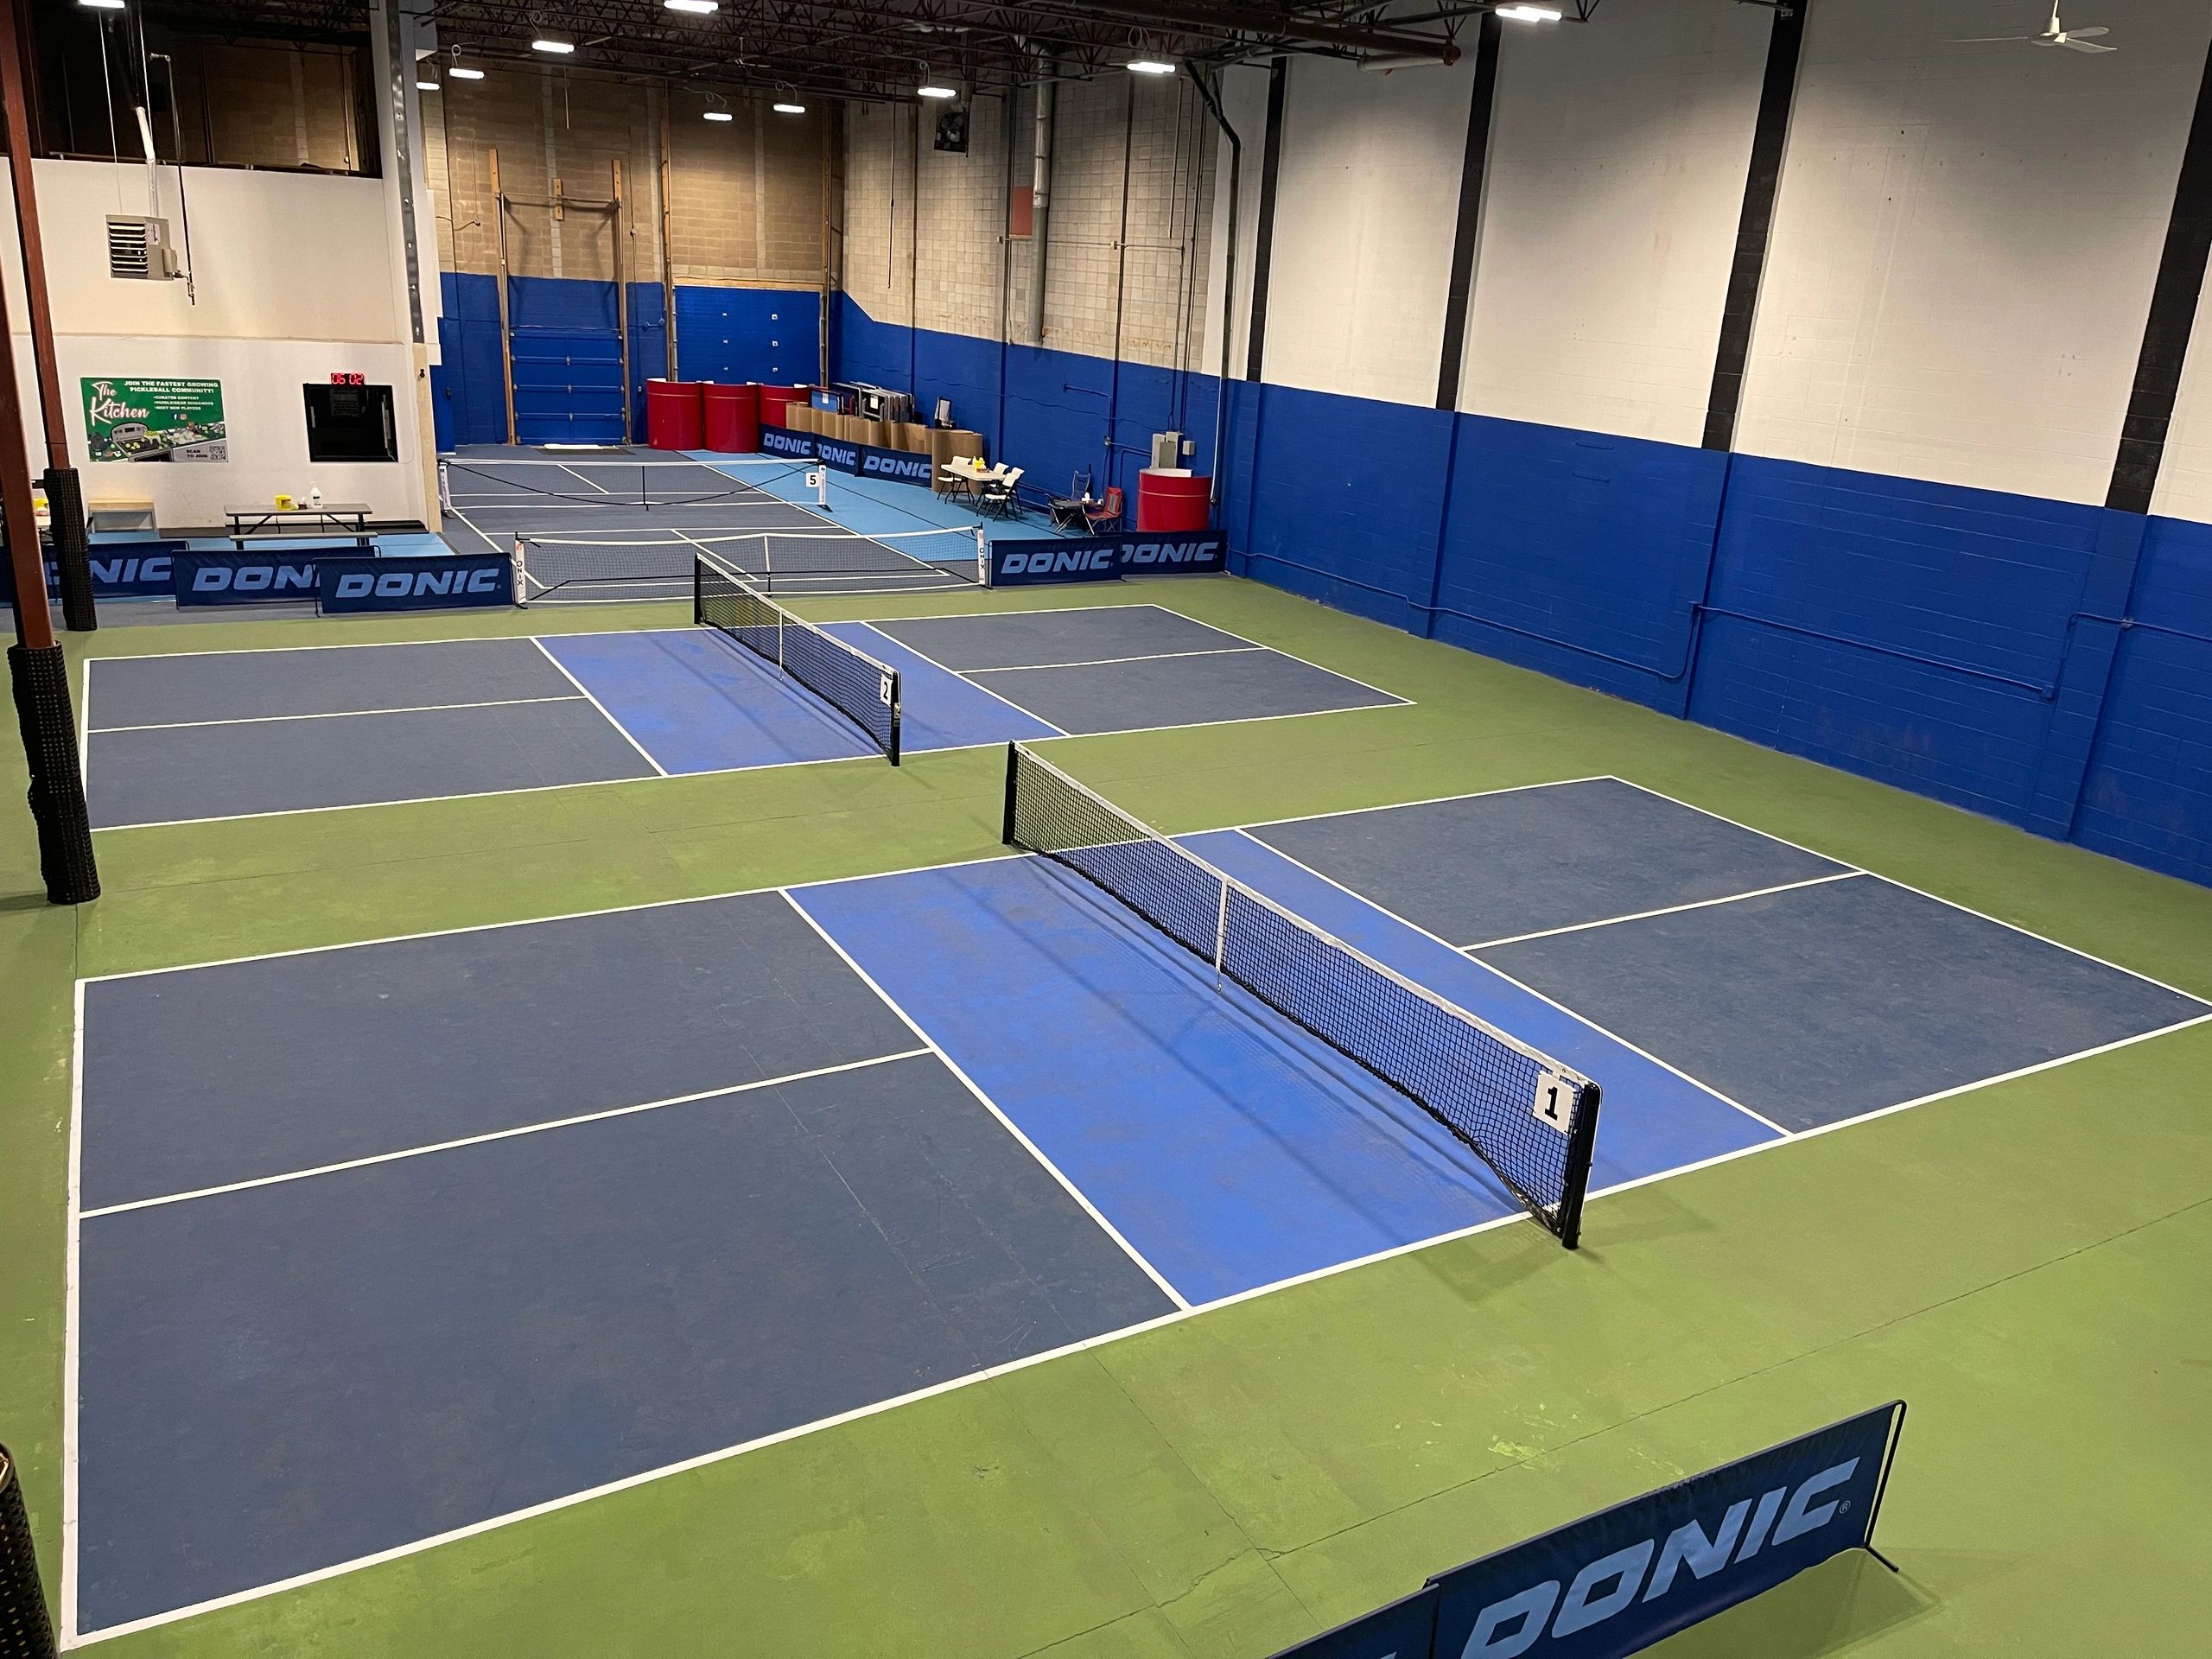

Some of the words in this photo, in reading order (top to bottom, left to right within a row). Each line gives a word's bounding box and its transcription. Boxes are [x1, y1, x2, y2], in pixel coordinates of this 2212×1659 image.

[92, 381, 118, 401] The
[90, 397, 149, 426] Kitchen
[763, 433, 811, 454] DONIC
[863, 455, 932, 478] DONIC
[810, 474, 817, 486] 5
[516, 561, 524, 586] ONIX
[1001, 549, 1114, 574] DONIC
[335, 568, 499, 598] DONIC
[883, 681, 888, 701] 2
[1544, 1085, 1559, 1121] 1
[1459, 1457, 1860, 1659] DONIC
